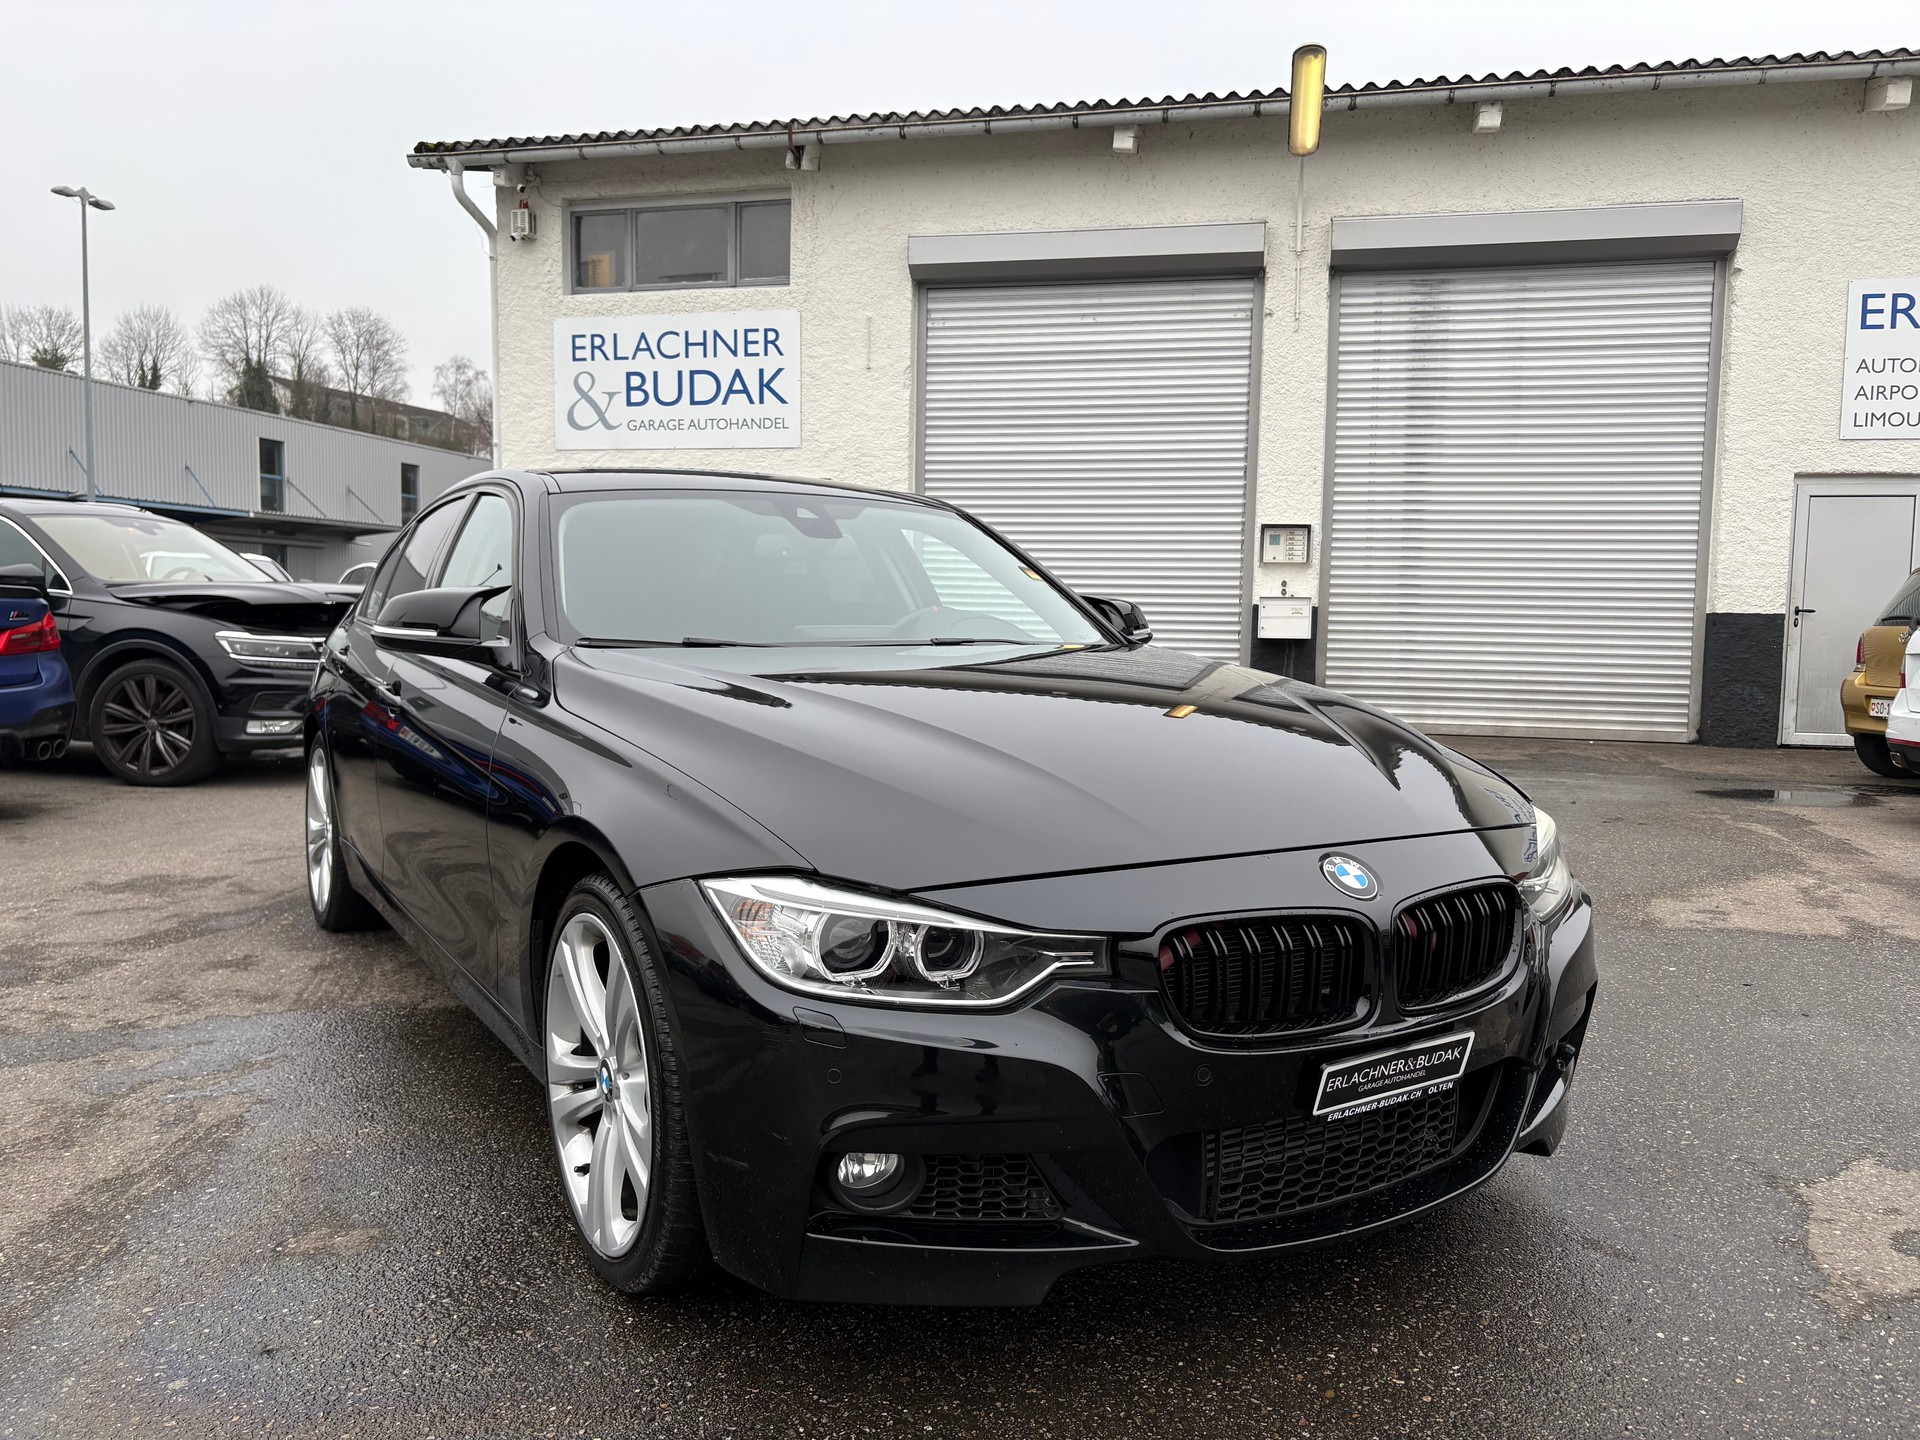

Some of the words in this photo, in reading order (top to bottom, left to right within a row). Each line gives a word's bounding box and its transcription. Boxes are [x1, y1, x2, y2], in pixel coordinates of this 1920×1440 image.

[1860, 293, 1920, 330] ER
[571, 328, 785, 362] ERLACHNER
[1856, 357, 1920, 373] AUTO
[566, 371, 622, 431] &
[625, 367, 789, 407] BUDAK
[1854, 385, 1919, 400] AIRPO
[627, 418, 685, 432] GARAGE
[687, 417, 790, 431] AUTOHANDEL
[1853, 412, 1920, 427] LIMOU
[1326, 1046, 1463, 1092] ERLACHNER&BUDAK
[1327, 1090, 1423, 1122] ERLACHNER-BUDAK.CH
[1428, 1081, 1454, 1095] OLTEN
